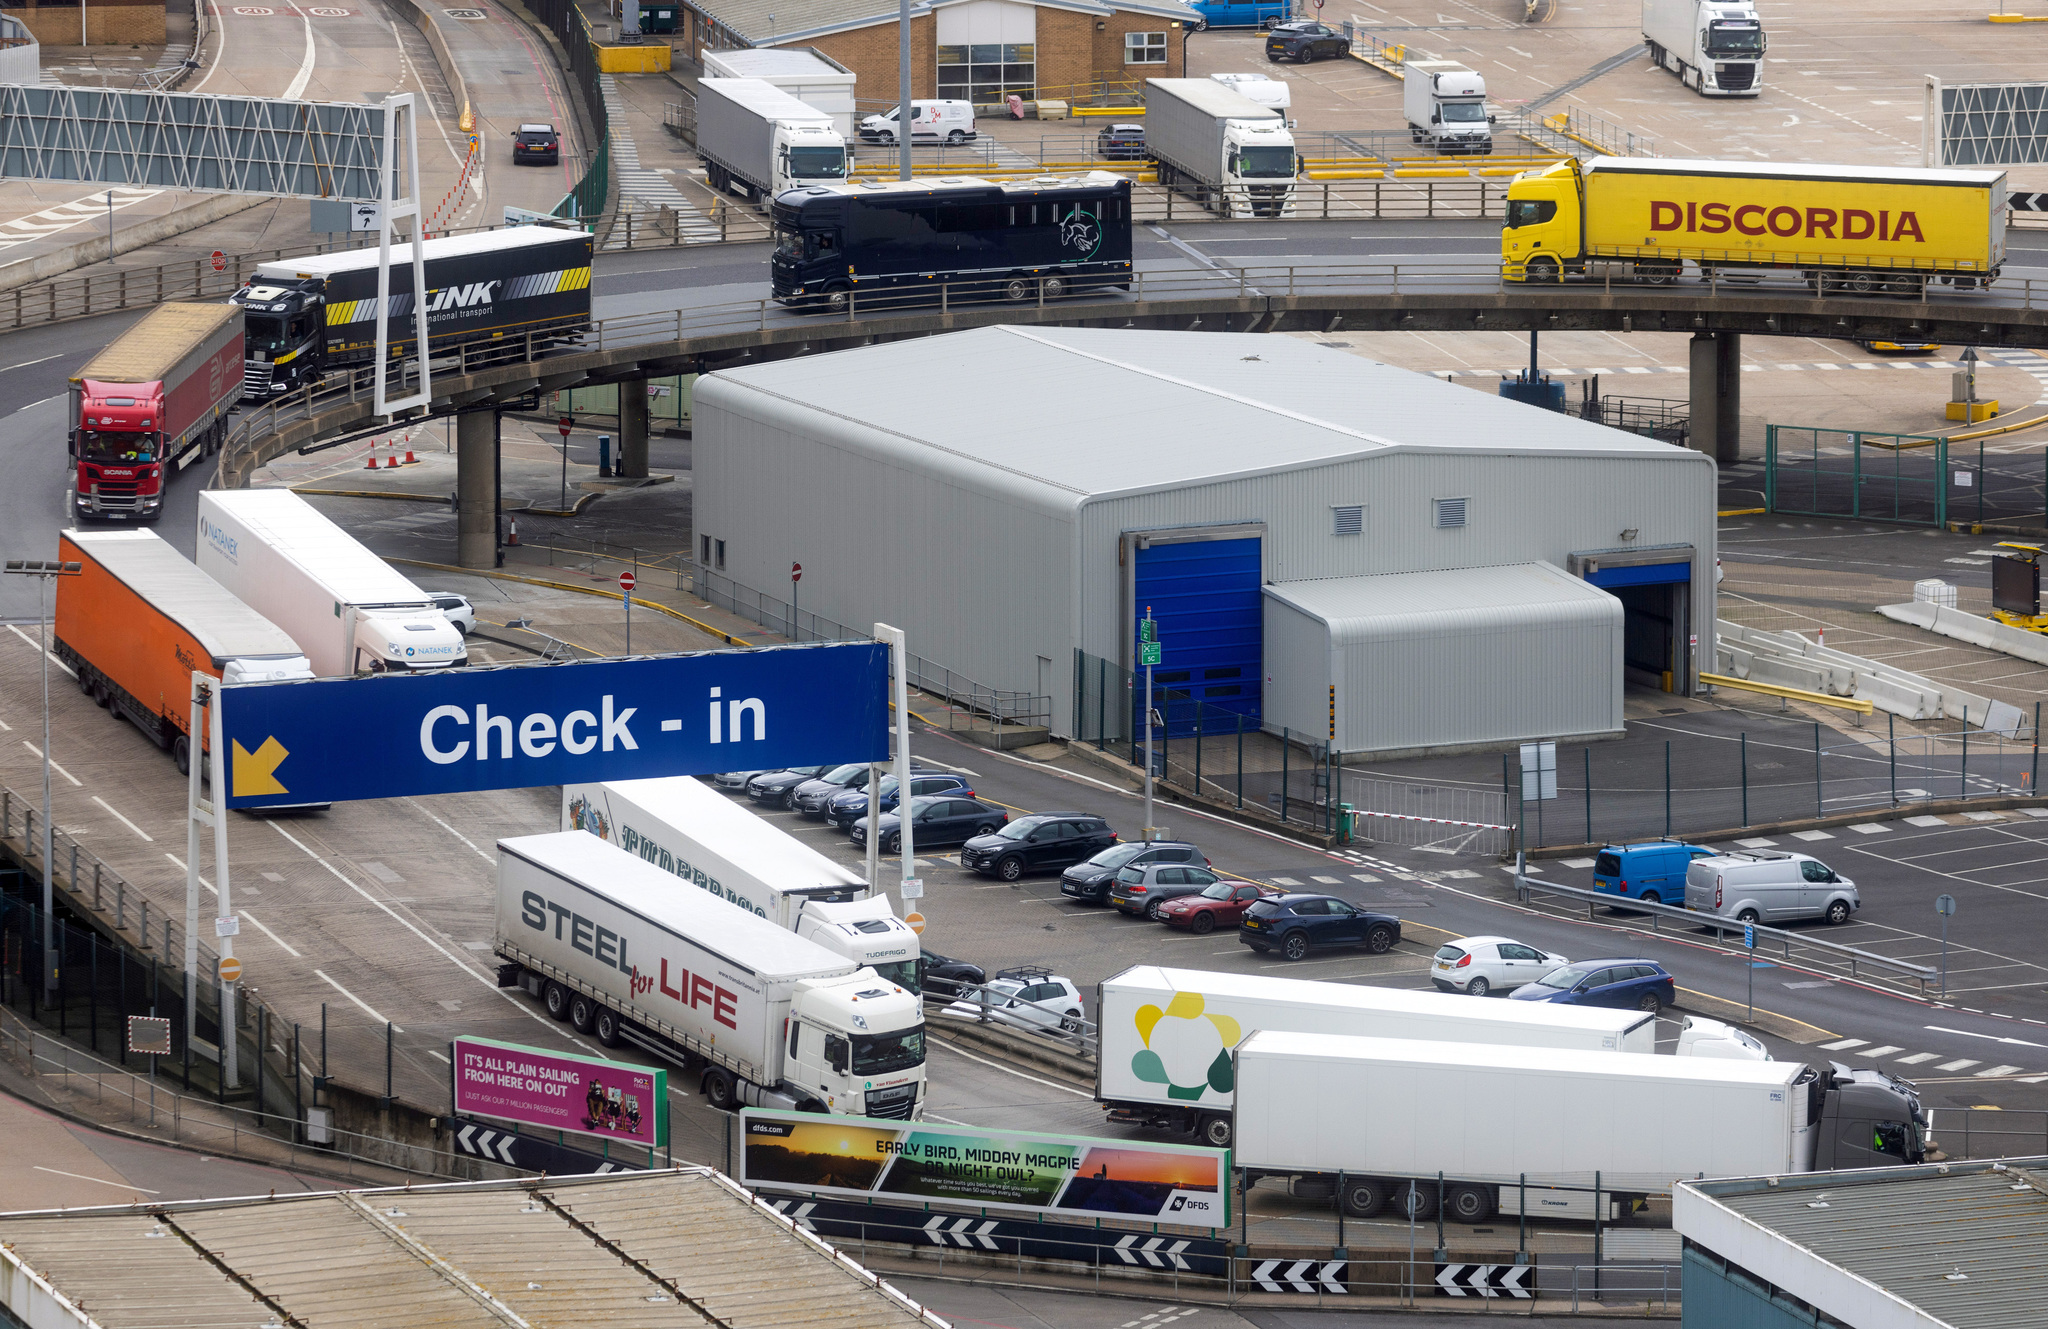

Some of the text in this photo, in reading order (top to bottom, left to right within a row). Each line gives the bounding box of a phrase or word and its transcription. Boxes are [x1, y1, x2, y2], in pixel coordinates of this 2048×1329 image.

[1650, 201, 1925, 242] DISCORDIA
[211, 257, 226, 265] STOP
[411, 311, 457, 325] Innational
[460, 306, 493, 319] transport
[208, 522, 238, 558] NATANEK
[418, 646, 453, 655] NATANEK
[419, 686, 766, 765] Check - in
[522, 890, 639, 979] STEEL
[866, 949, 906, 958] TUDEFRIGO
[630, 957, 738, 1031] for LIFE
[464, 1053, 580, 1085] IT'S ALL PLAIN SAILING
[465, 1068, 568, 1097] FROM HERE ON OUT
[492, 1096, 505, 1105] OUR
[510, 1099, 533, 1110] MILLION
[882, 1091, 901, 1099] DAF
[752, 1124, 783, 1134] dfds.com
[876, 1140, 1080, 1170] EARLY BIRD, MIDDAY MAGPIE
[924, 1160, 1035, 1181] OR NIGHT OWL?
[1187, 1200, 1209, 1211] DFDS
